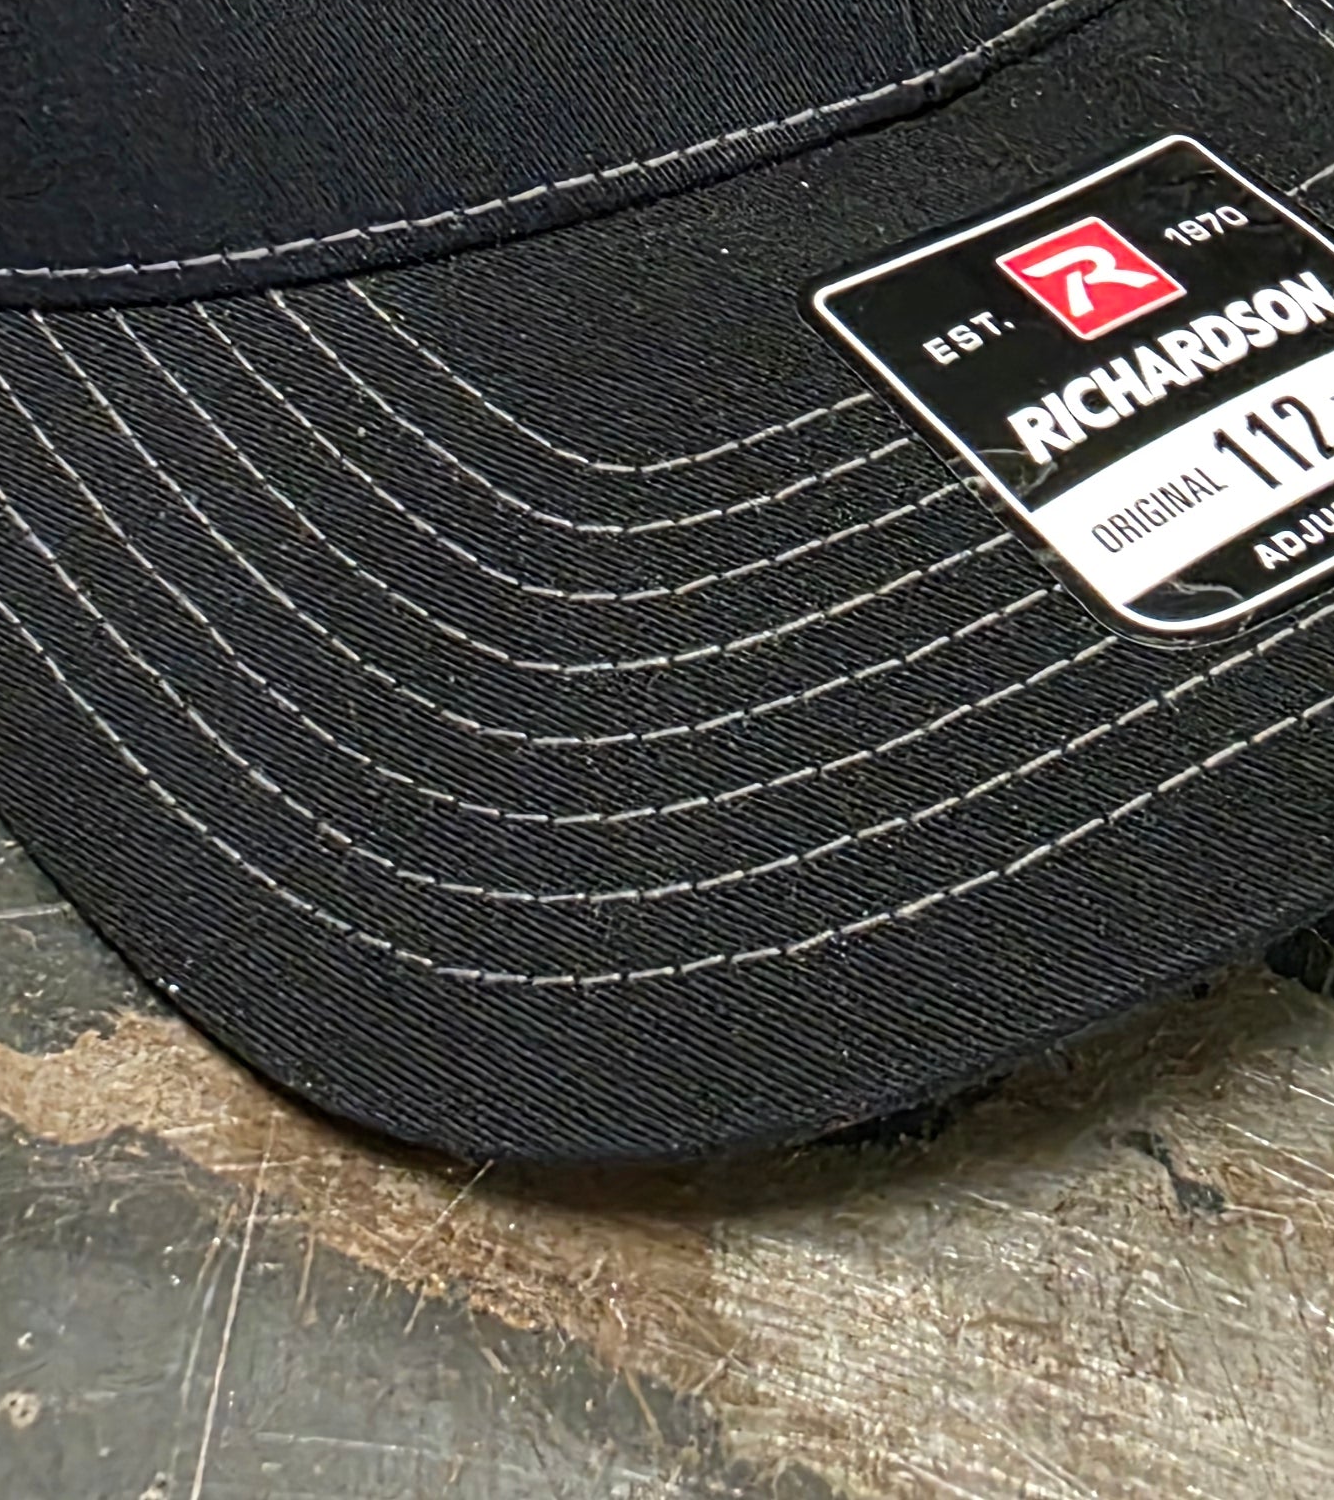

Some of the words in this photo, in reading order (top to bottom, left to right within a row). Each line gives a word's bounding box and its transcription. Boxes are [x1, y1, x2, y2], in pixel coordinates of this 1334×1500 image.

[922, 310, 1016, 365] EST.
[1164, 205, 1249, 247] 1970
[1021, 245, 1159, 318] R
[1091, 467, 1229, 554] ORIGINAL
